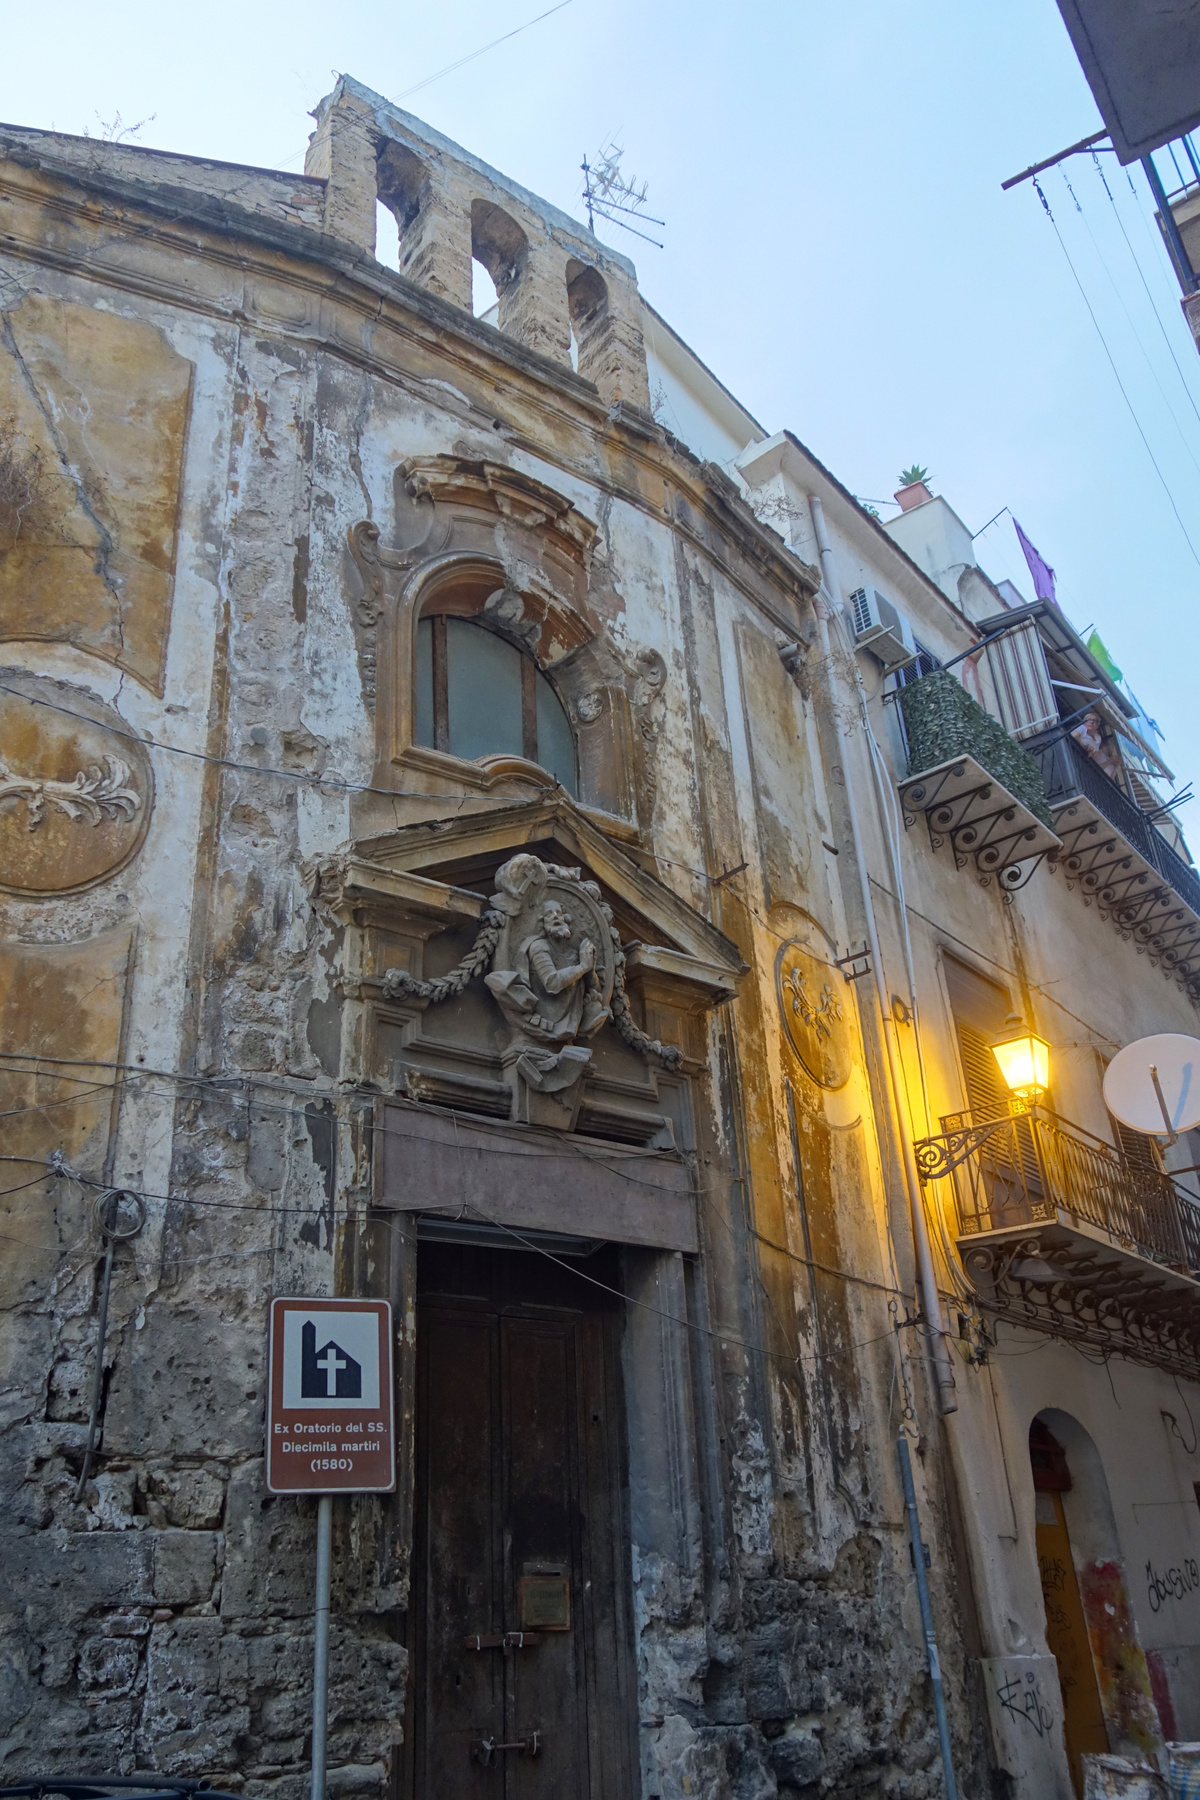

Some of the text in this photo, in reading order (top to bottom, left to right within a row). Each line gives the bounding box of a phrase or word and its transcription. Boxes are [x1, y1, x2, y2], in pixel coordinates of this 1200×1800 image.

[274, 1422, 387, 1433] Ex Oratorio del SS.
[282, 1440, 380, 1452] Diecimila martiri
[310, 1458, 353, 1472] (1580)
